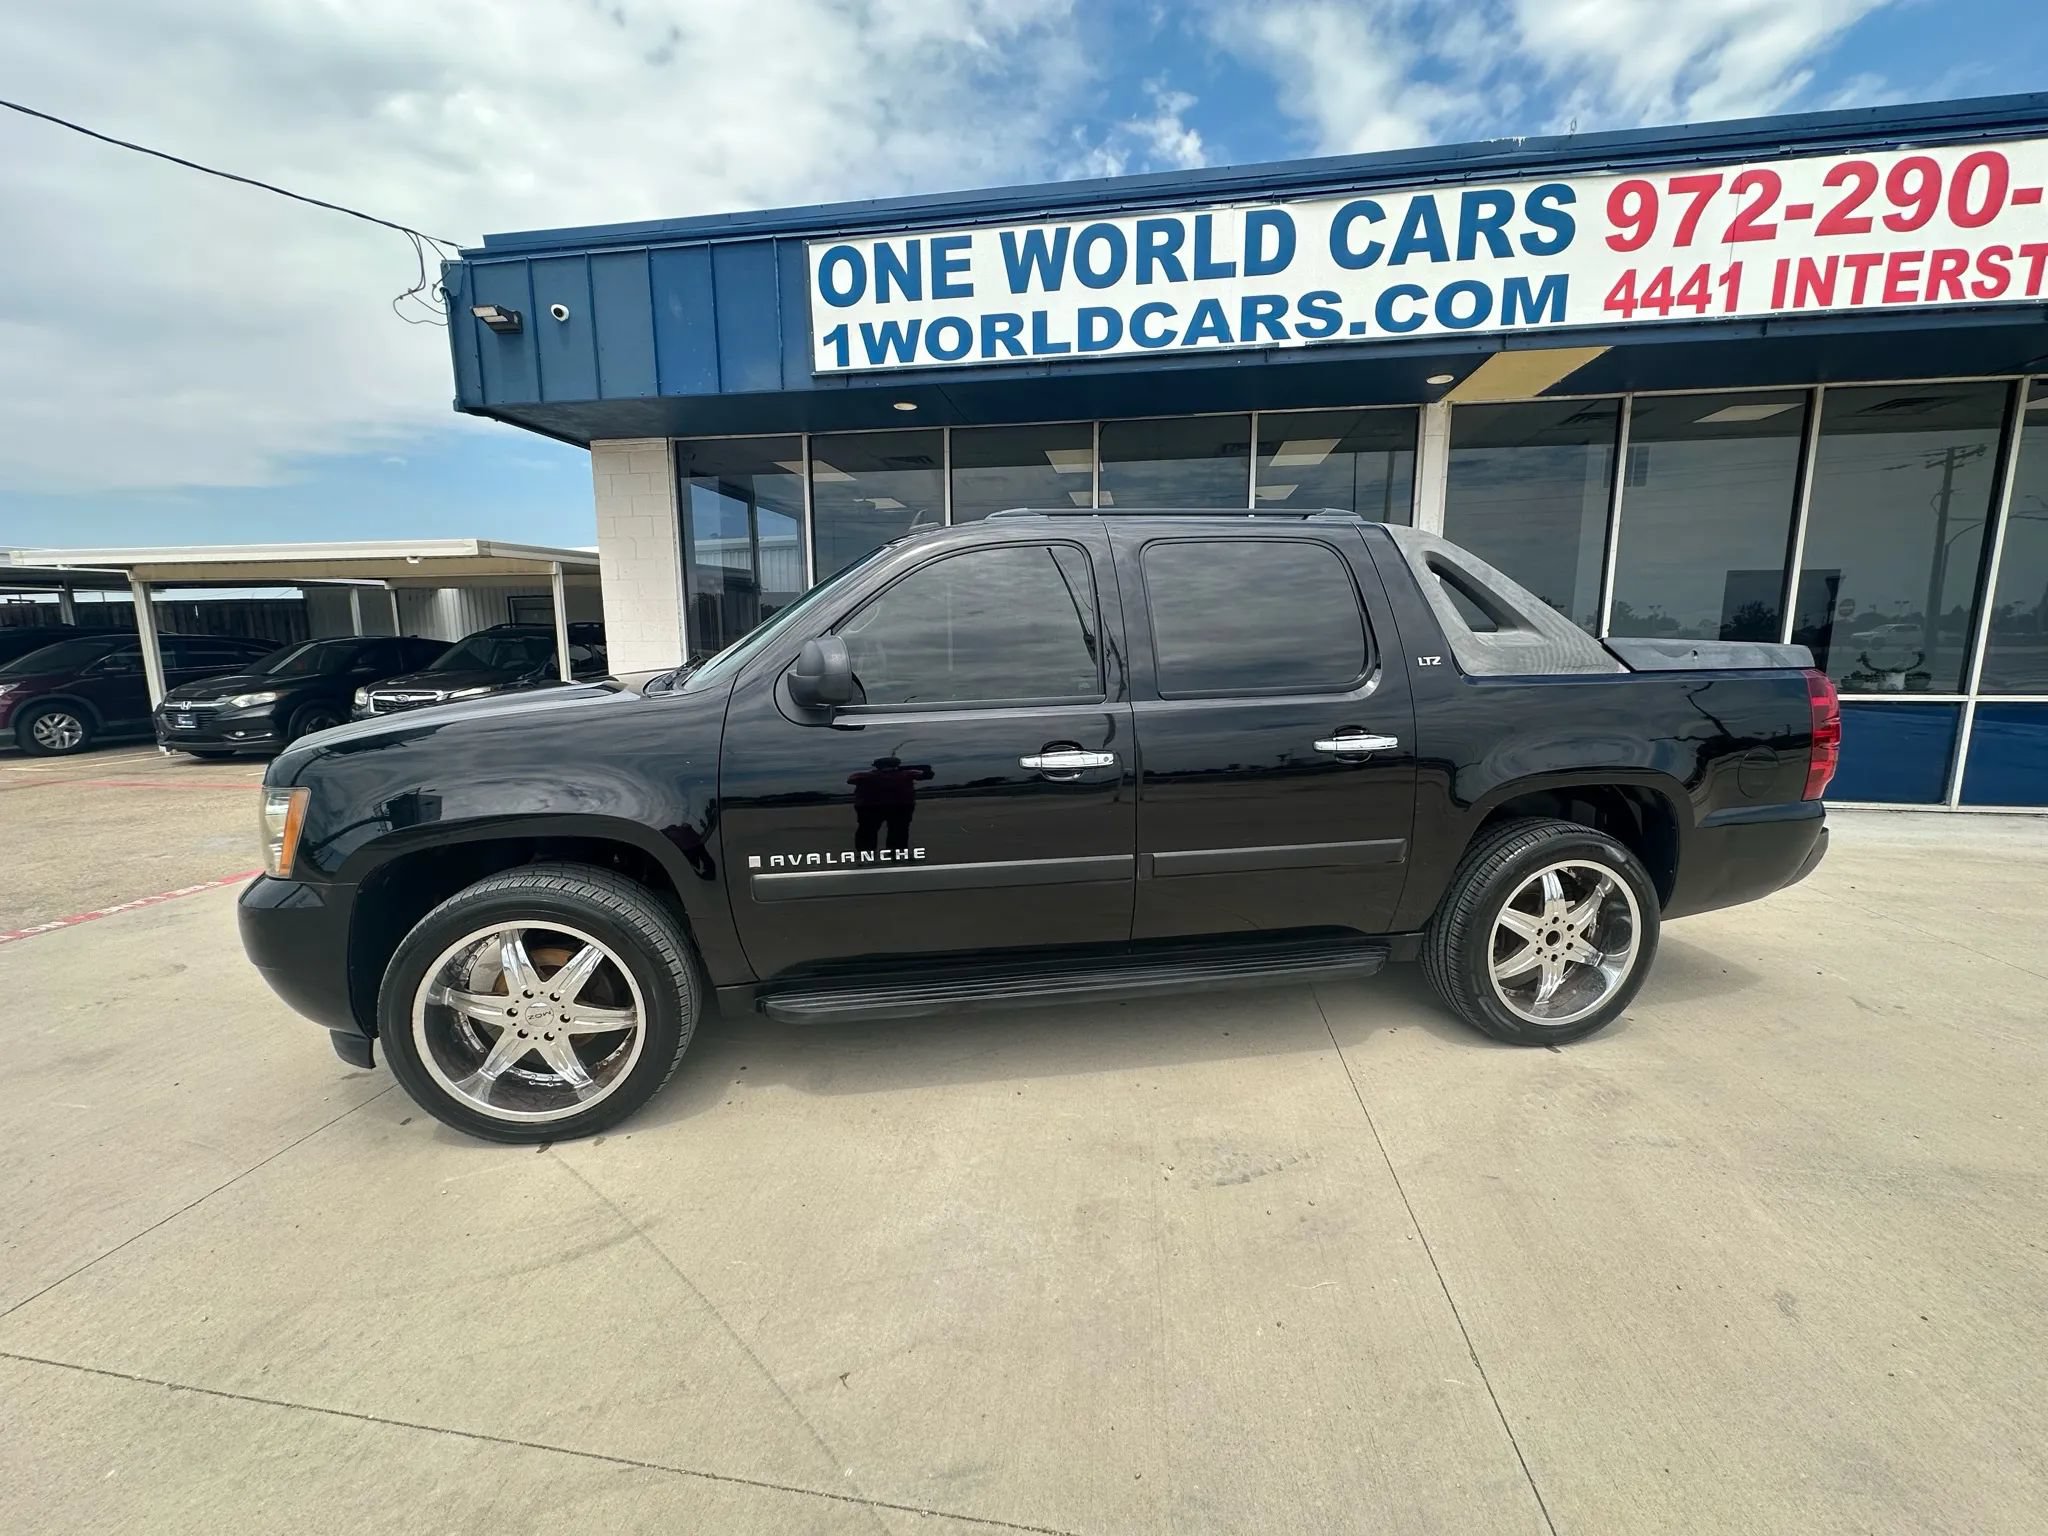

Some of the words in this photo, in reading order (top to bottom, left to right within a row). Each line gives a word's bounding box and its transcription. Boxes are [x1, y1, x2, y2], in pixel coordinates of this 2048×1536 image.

[1605, 151, 2043, 253] 972-290-
[818, 235, 974, 308] ONE
[1000, 209, 1297, 294] WORLD
[1329, 183, 1576, 270] CARS
[1603, 261, 1743, 319] 4441
[1770, 242, 2048, 310] INTERST
[822, 274, 1569, 368] 1WORLDCARS.COM
[1417, 655, 1442, 666] LTZ
[769, 847, 926, 867] AVALANCHE
